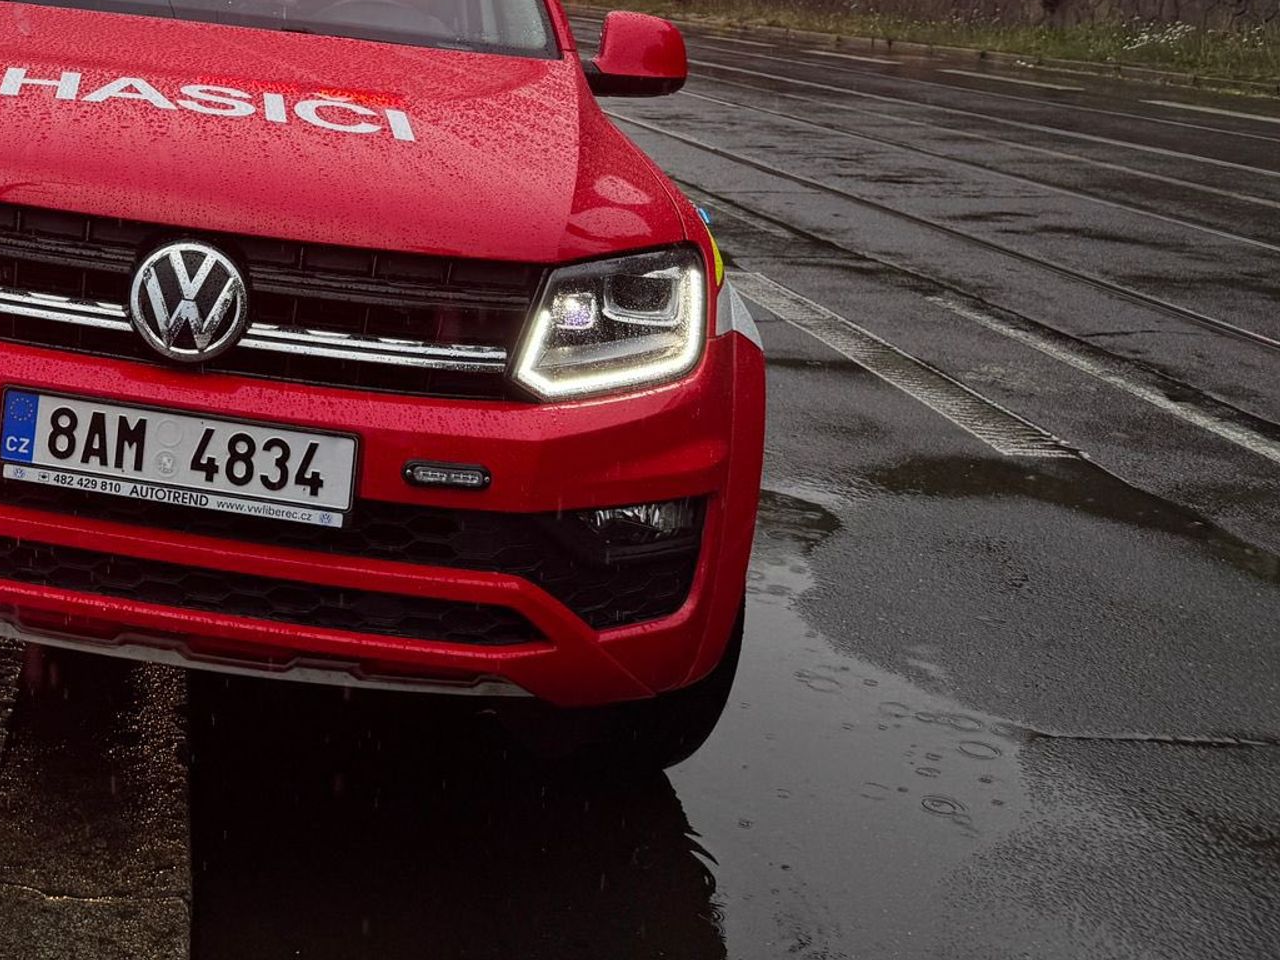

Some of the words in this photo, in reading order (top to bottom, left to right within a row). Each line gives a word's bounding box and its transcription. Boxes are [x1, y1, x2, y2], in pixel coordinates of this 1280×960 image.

[5, 435, 30, 455] CZ
[46, 407, 148, 472] 8AM
[190, 427, 324, 497] 4834
[53, 473, 74, 486] 482
[76, 477, 98, 490] 429
[100, 481, 121, 493] 810
[129, 484, 209, 507] AUTOTREND
[216, 500, 313, 522] www.vwliberec.cz
